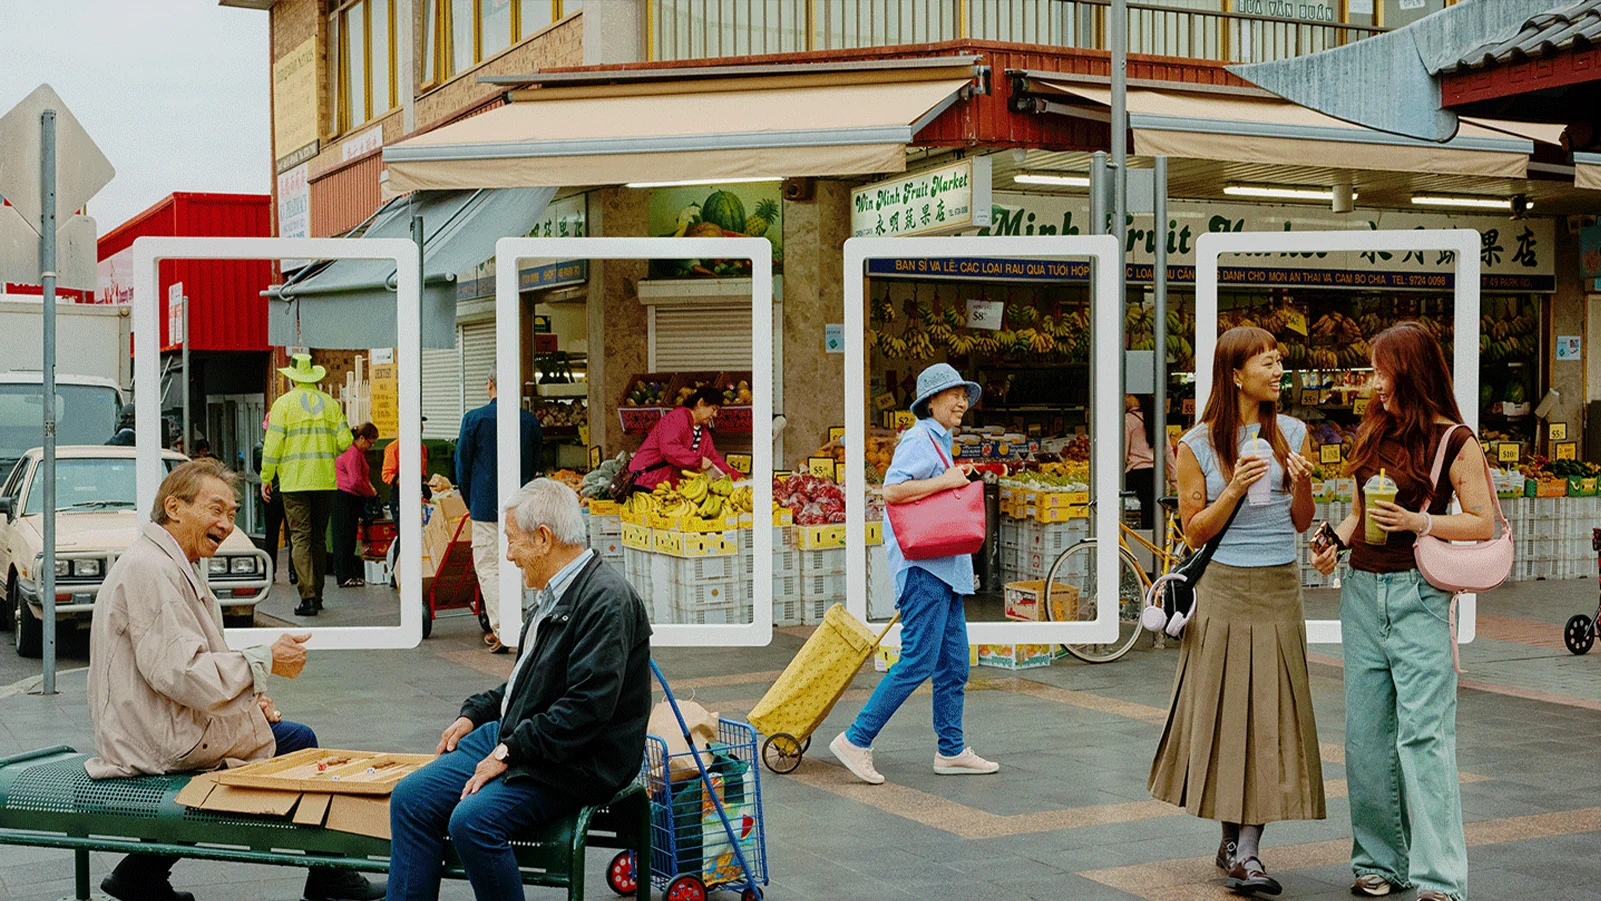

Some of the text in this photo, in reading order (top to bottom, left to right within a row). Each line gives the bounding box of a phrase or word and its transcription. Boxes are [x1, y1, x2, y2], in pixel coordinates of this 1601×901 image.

[855, 172, 968, 213] Win Minh Fruit Market
[1106, 212, 1191, 254] ruit
[1005, 263, 1024, 275] RAU
[1166, 269, 1175, 280] AU
[1247, 271, 1266, 282] CHO
